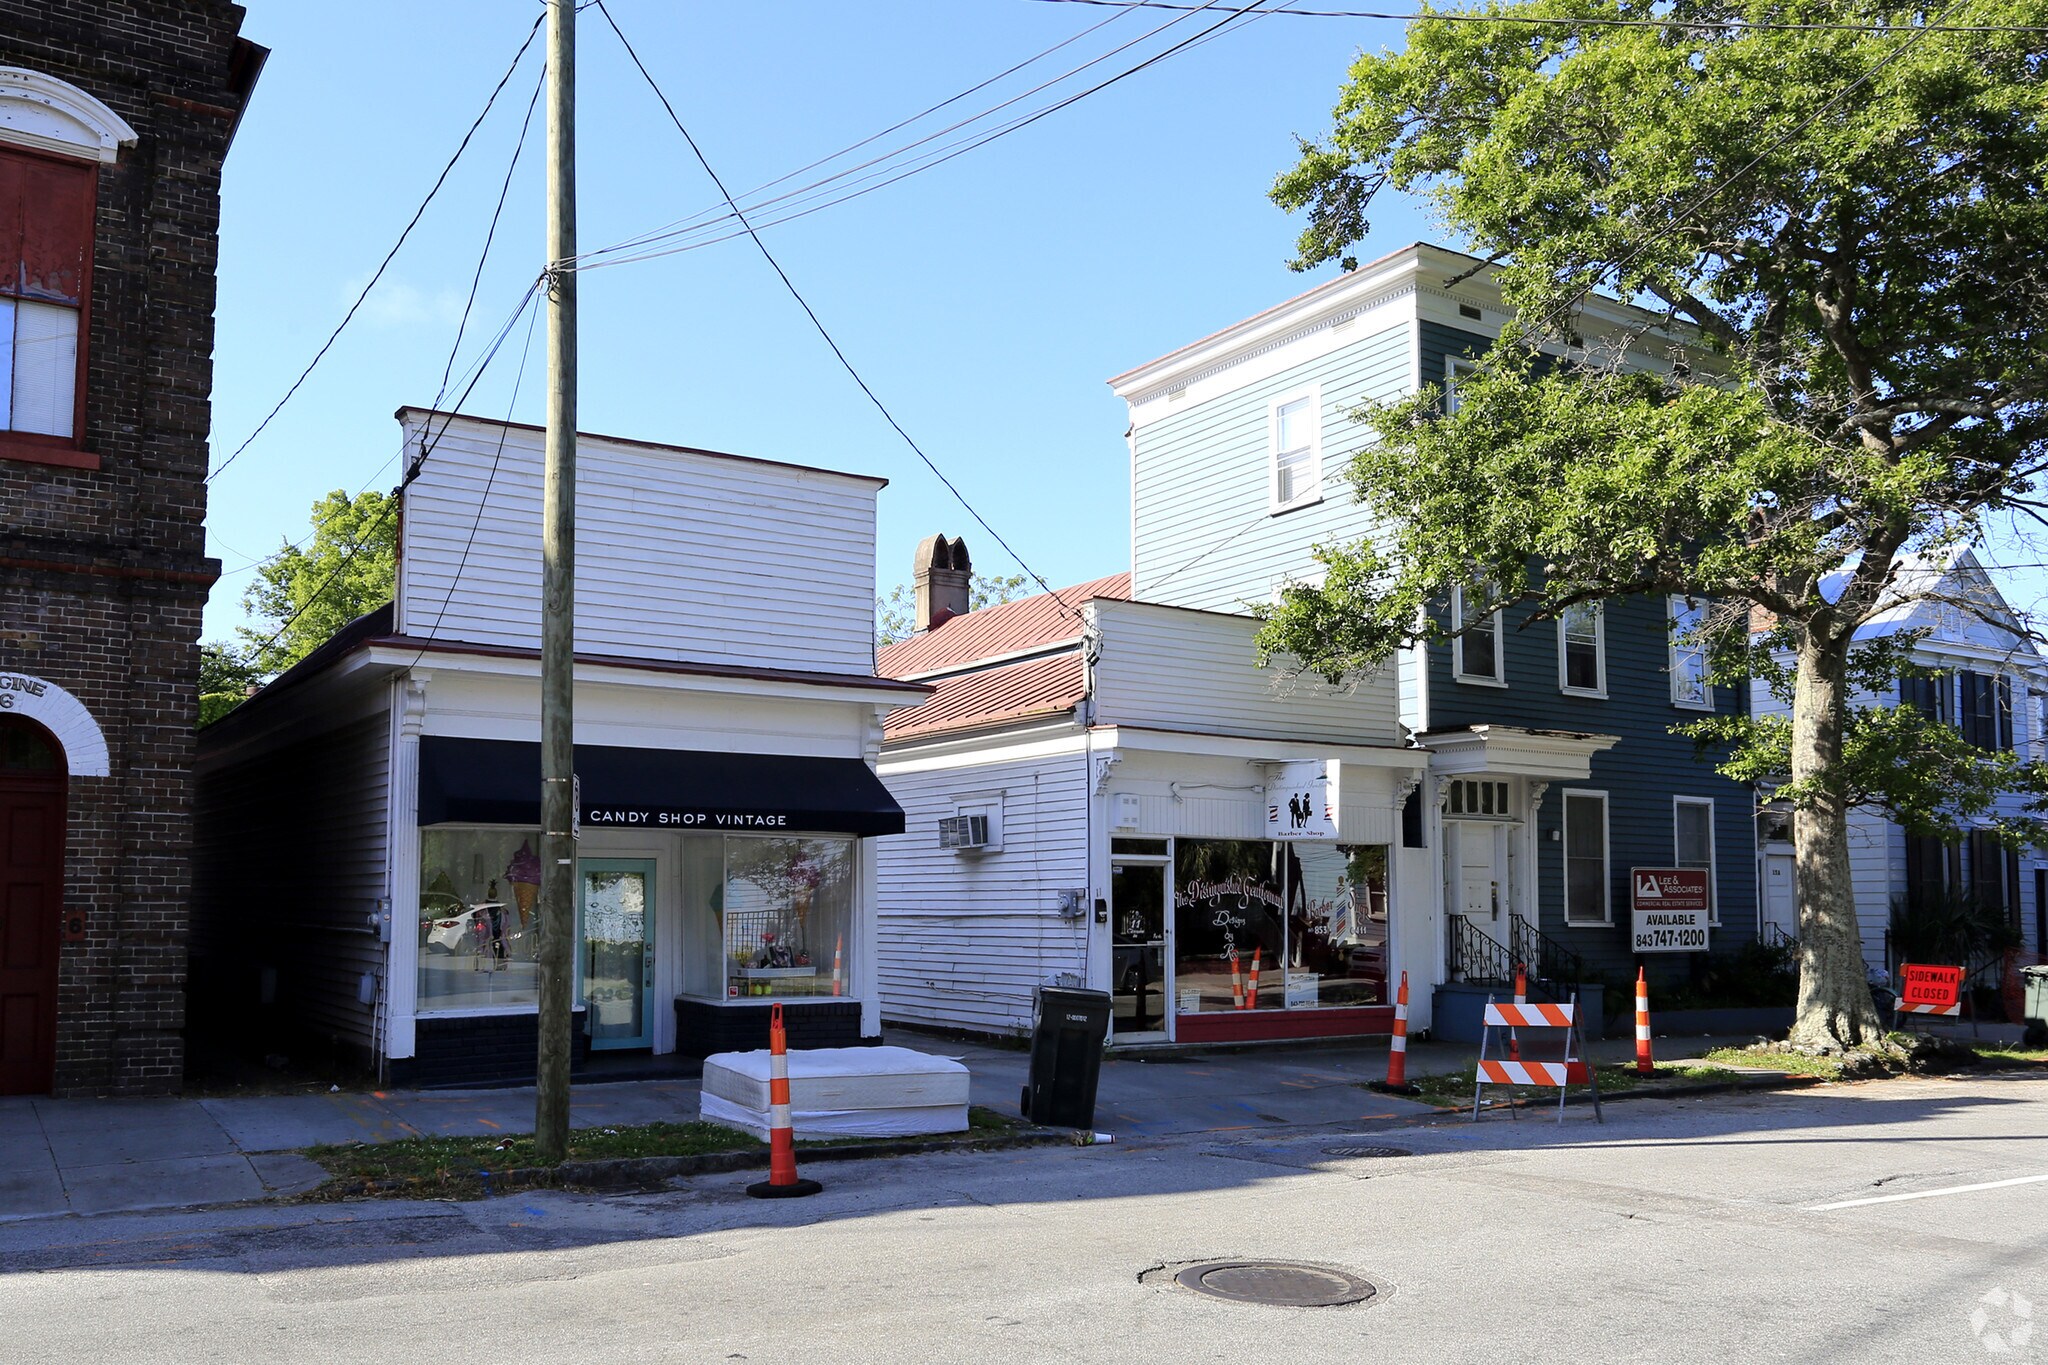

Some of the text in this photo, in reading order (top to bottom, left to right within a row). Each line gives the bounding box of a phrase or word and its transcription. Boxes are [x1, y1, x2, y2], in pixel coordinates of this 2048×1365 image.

[590, 810, 786, 826] CANDY SHOP VINTAGE
[70, 917, 82, 934] 6
[1213, 910, 1246, 928] Designs
[1646, 914, 1695, 926] AVAILABLE
[1636, 929, 1705, 947] 843 747-1200
[1909, 970, 1956, 983] SIDEWALK
[1911, 987, 1949, 1000] CLOSED
